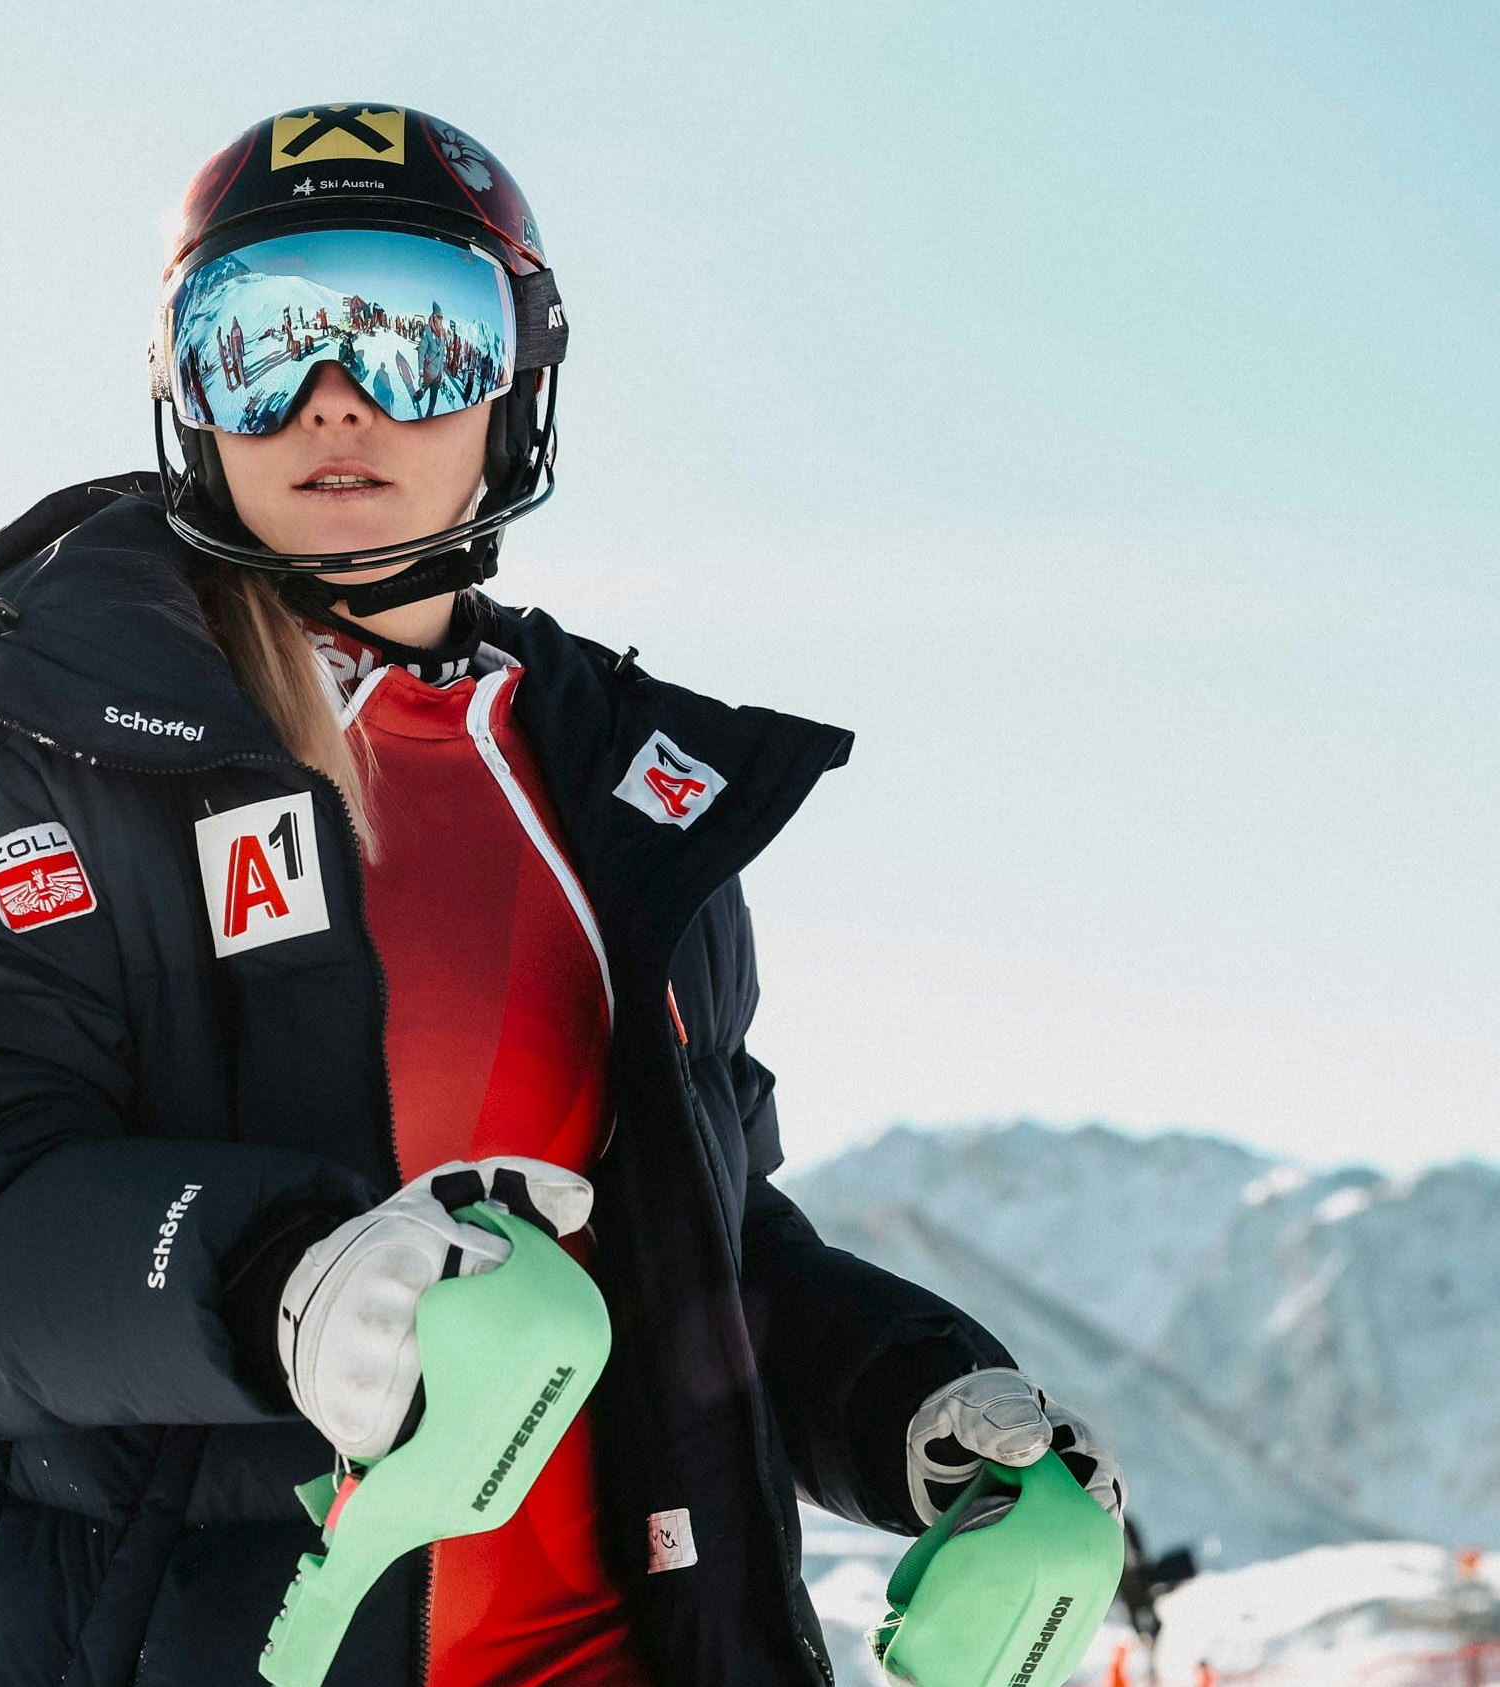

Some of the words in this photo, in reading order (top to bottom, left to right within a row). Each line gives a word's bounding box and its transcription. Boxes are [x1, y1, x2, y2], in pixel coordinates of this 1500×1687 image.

[320, 179, 338, 189] Ski
[342, 179, 385, 189] Austria
[643, 742, 708, 818] A1
[223, 811, 304, 938] A1
[471, 1366, 573, 1513] KOMPERDELL
